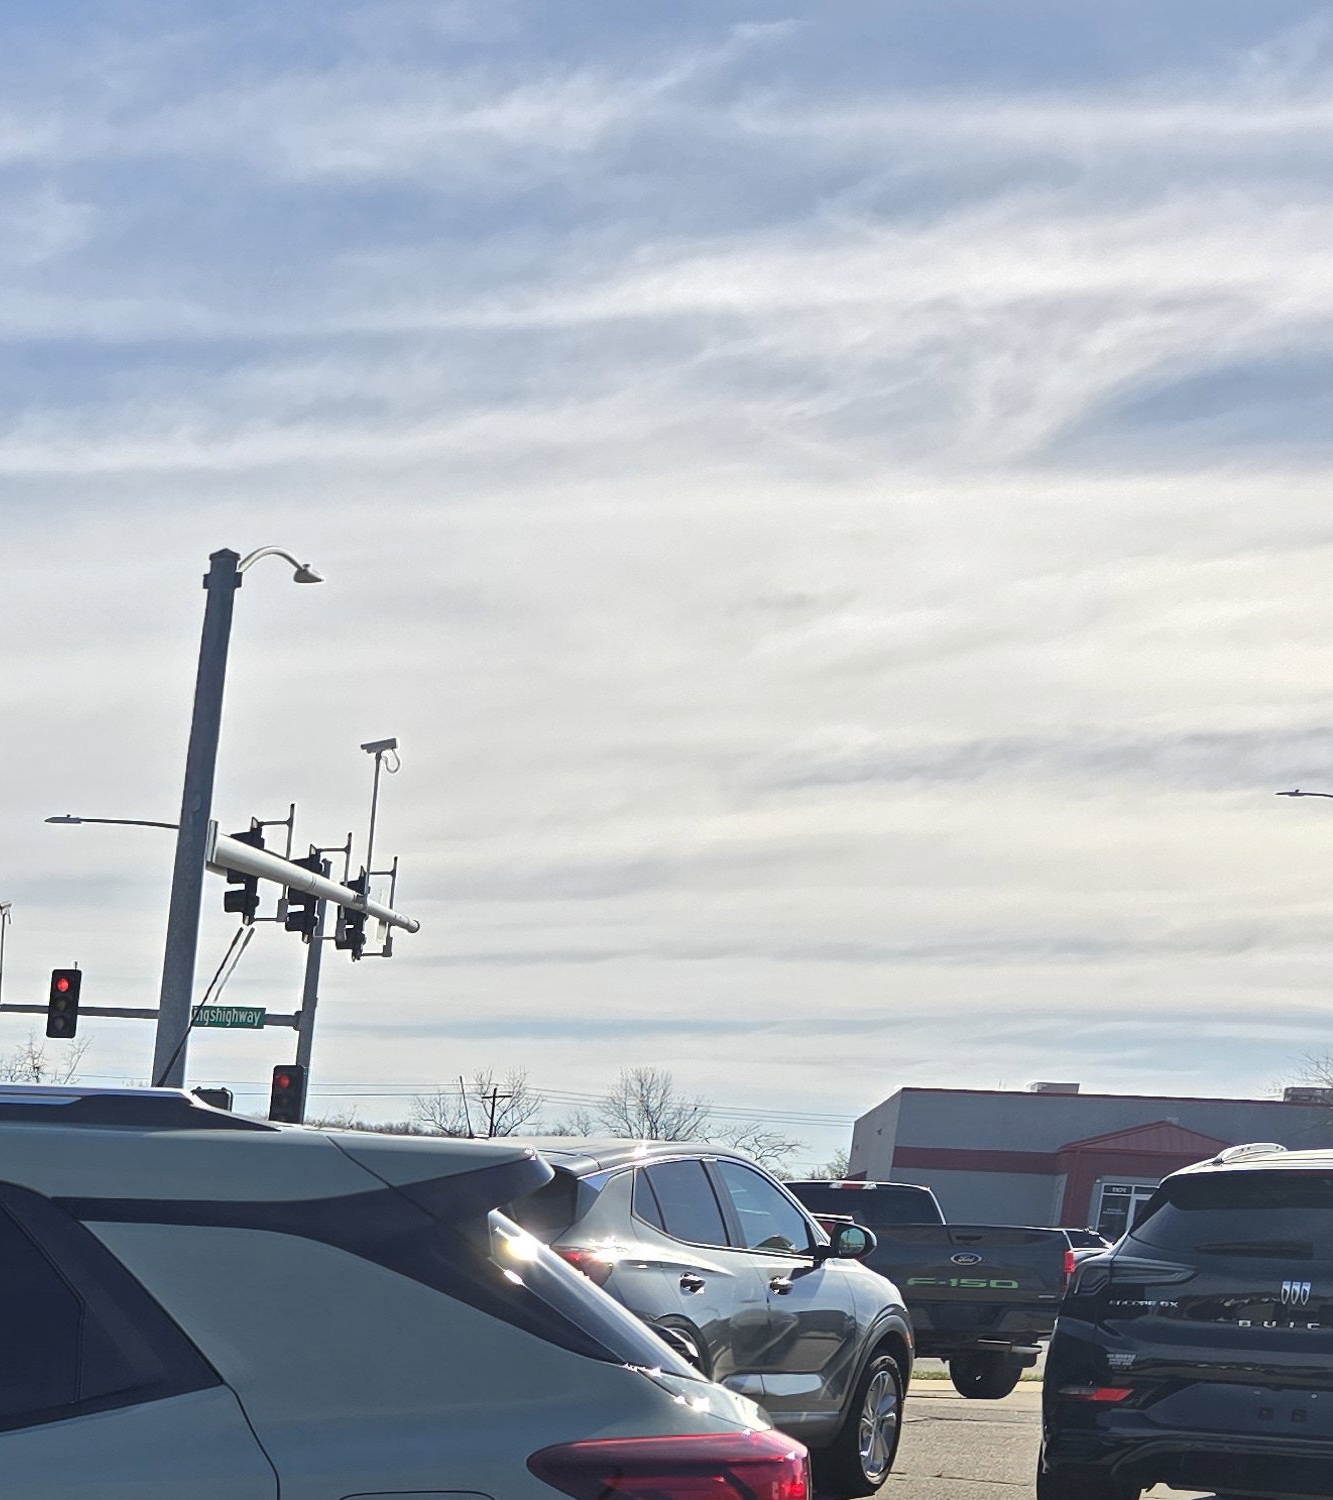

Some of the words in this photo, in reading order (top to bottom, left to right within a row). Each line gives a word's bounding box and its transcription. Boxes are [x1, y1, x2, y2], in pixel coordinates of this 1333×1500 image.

[193, 1006, 261, 1027] ingshighway
[957, 1255, 976, 1263] Ford
[907, 1277, 1019, 1289] F-150
[1238, 1320, 1321, 1329] BUIC
